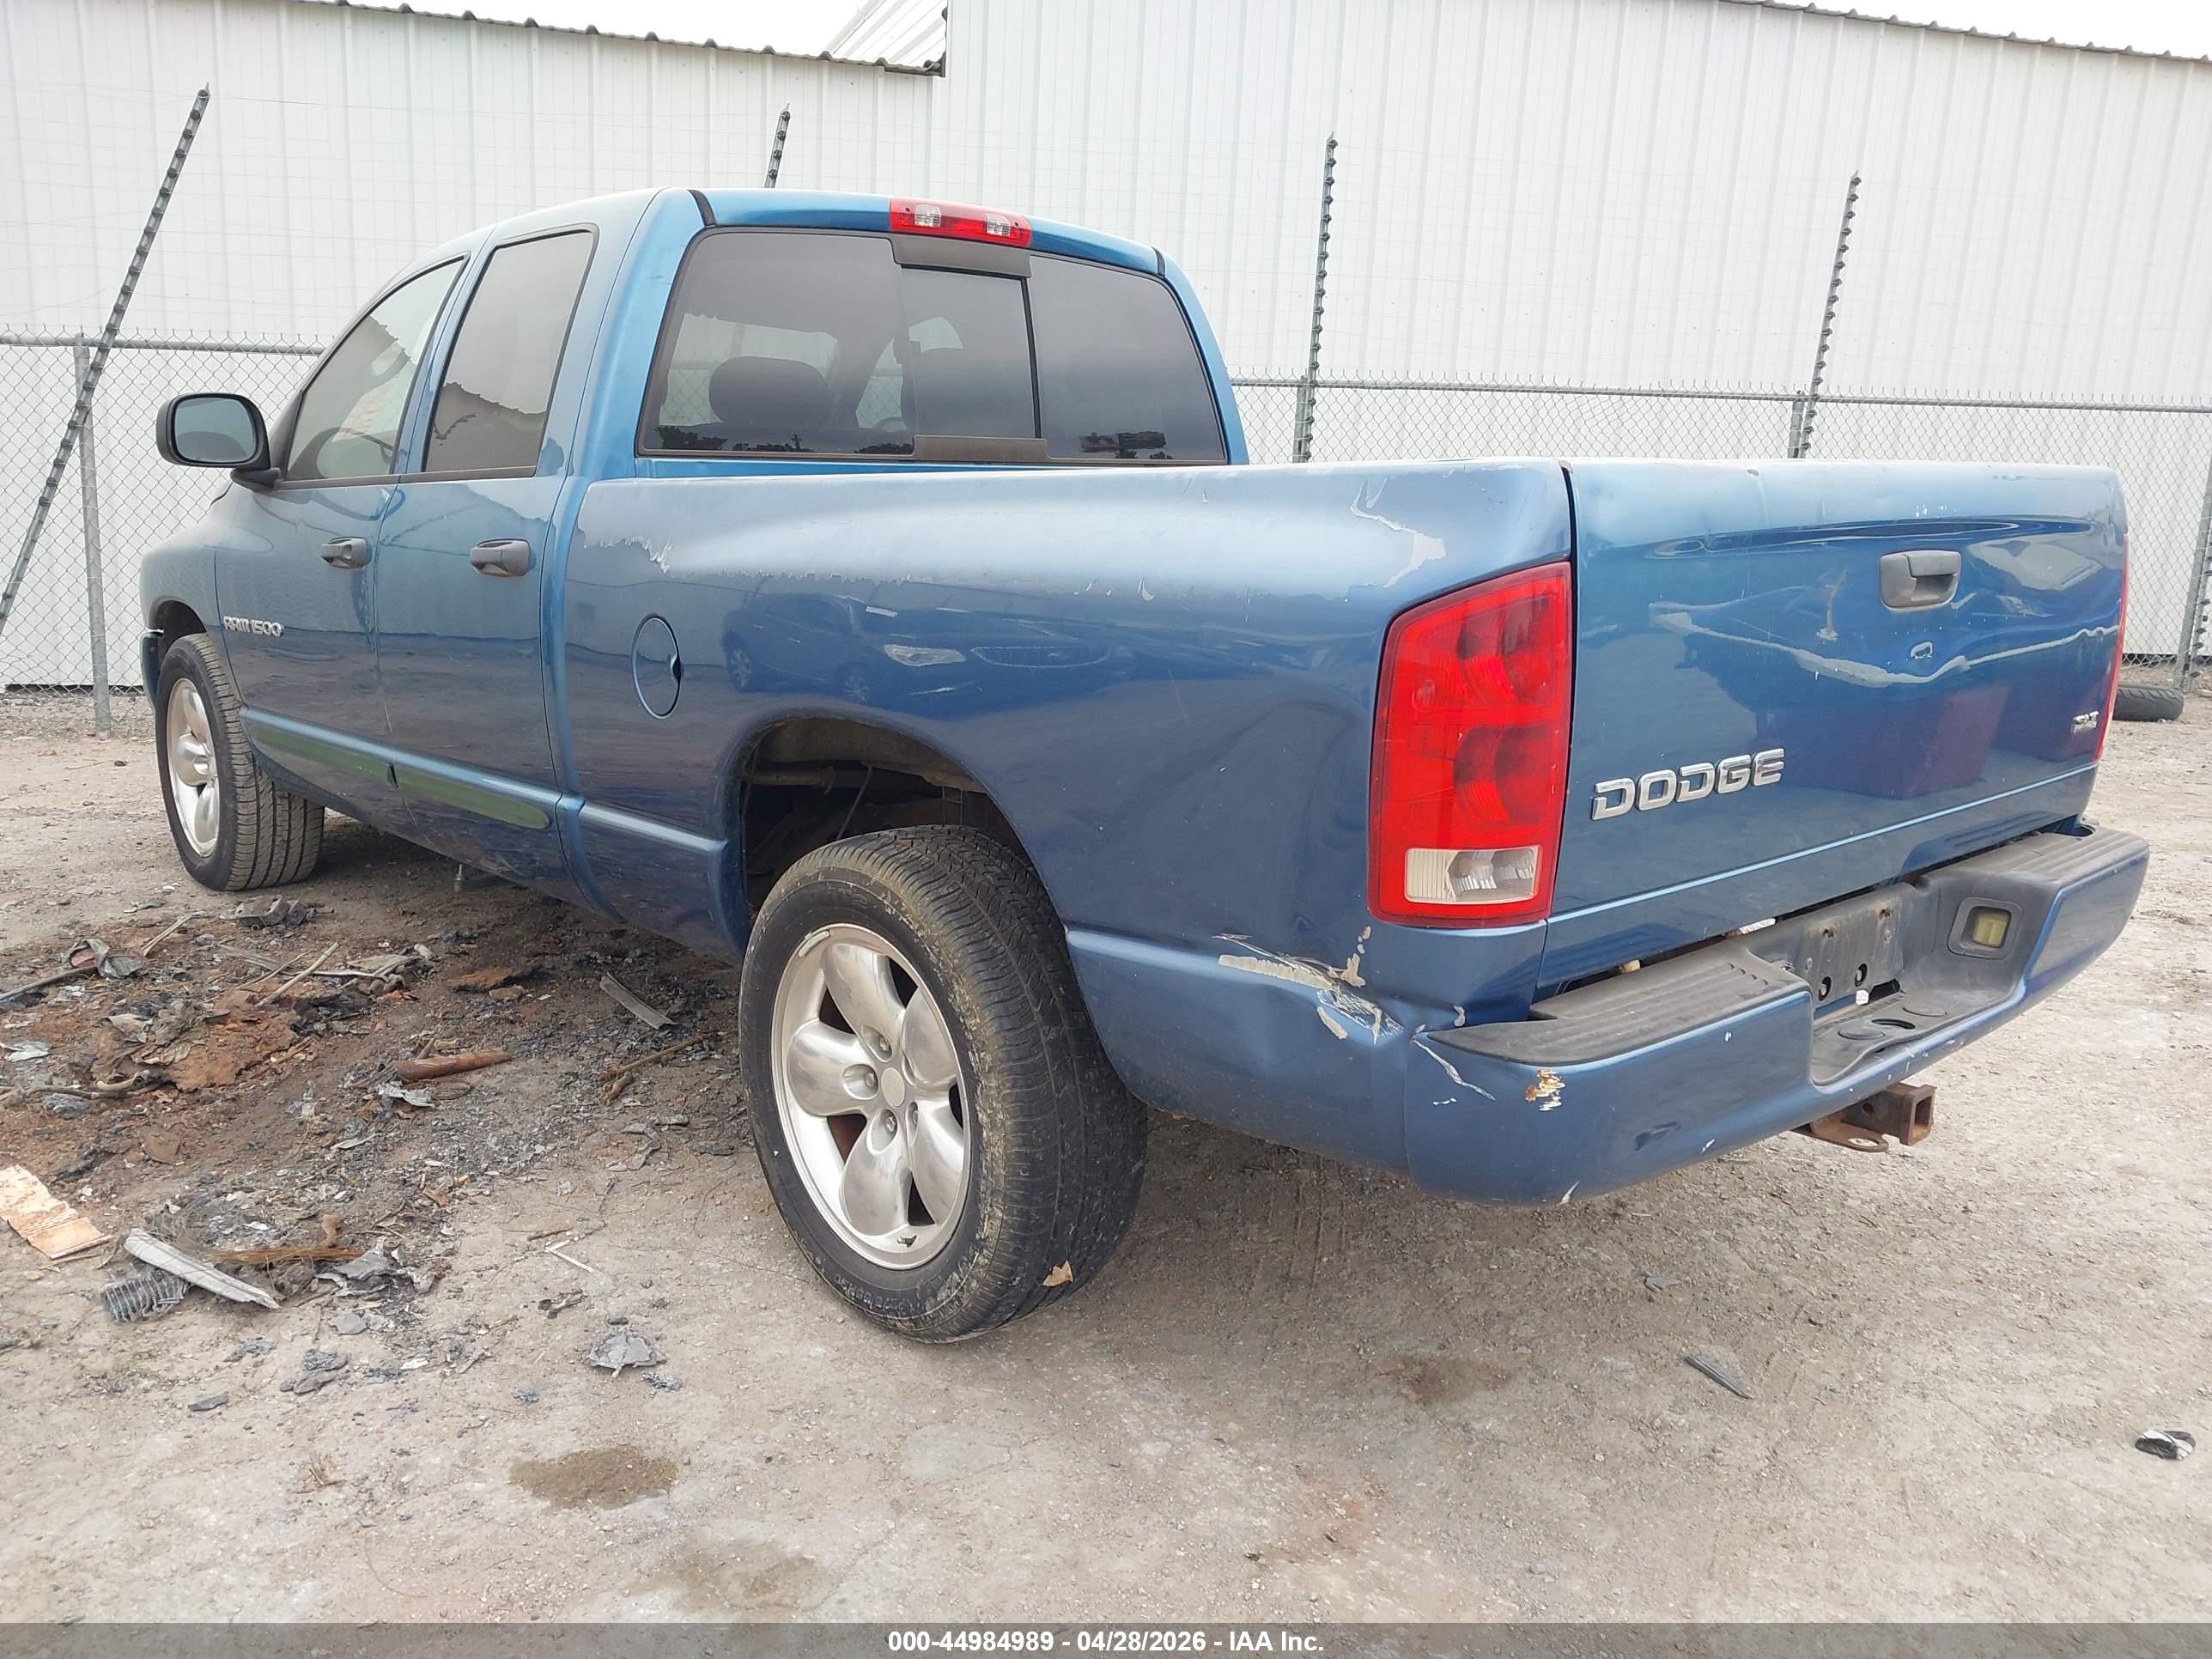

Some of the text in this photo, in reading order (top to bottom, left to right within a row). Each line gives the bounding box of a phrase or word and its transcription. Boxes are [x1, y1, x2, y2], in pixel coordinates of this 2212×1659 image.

[223, 616, 283, 637] RAM 1500
[1590, 748, 1785, 821] DODGE
